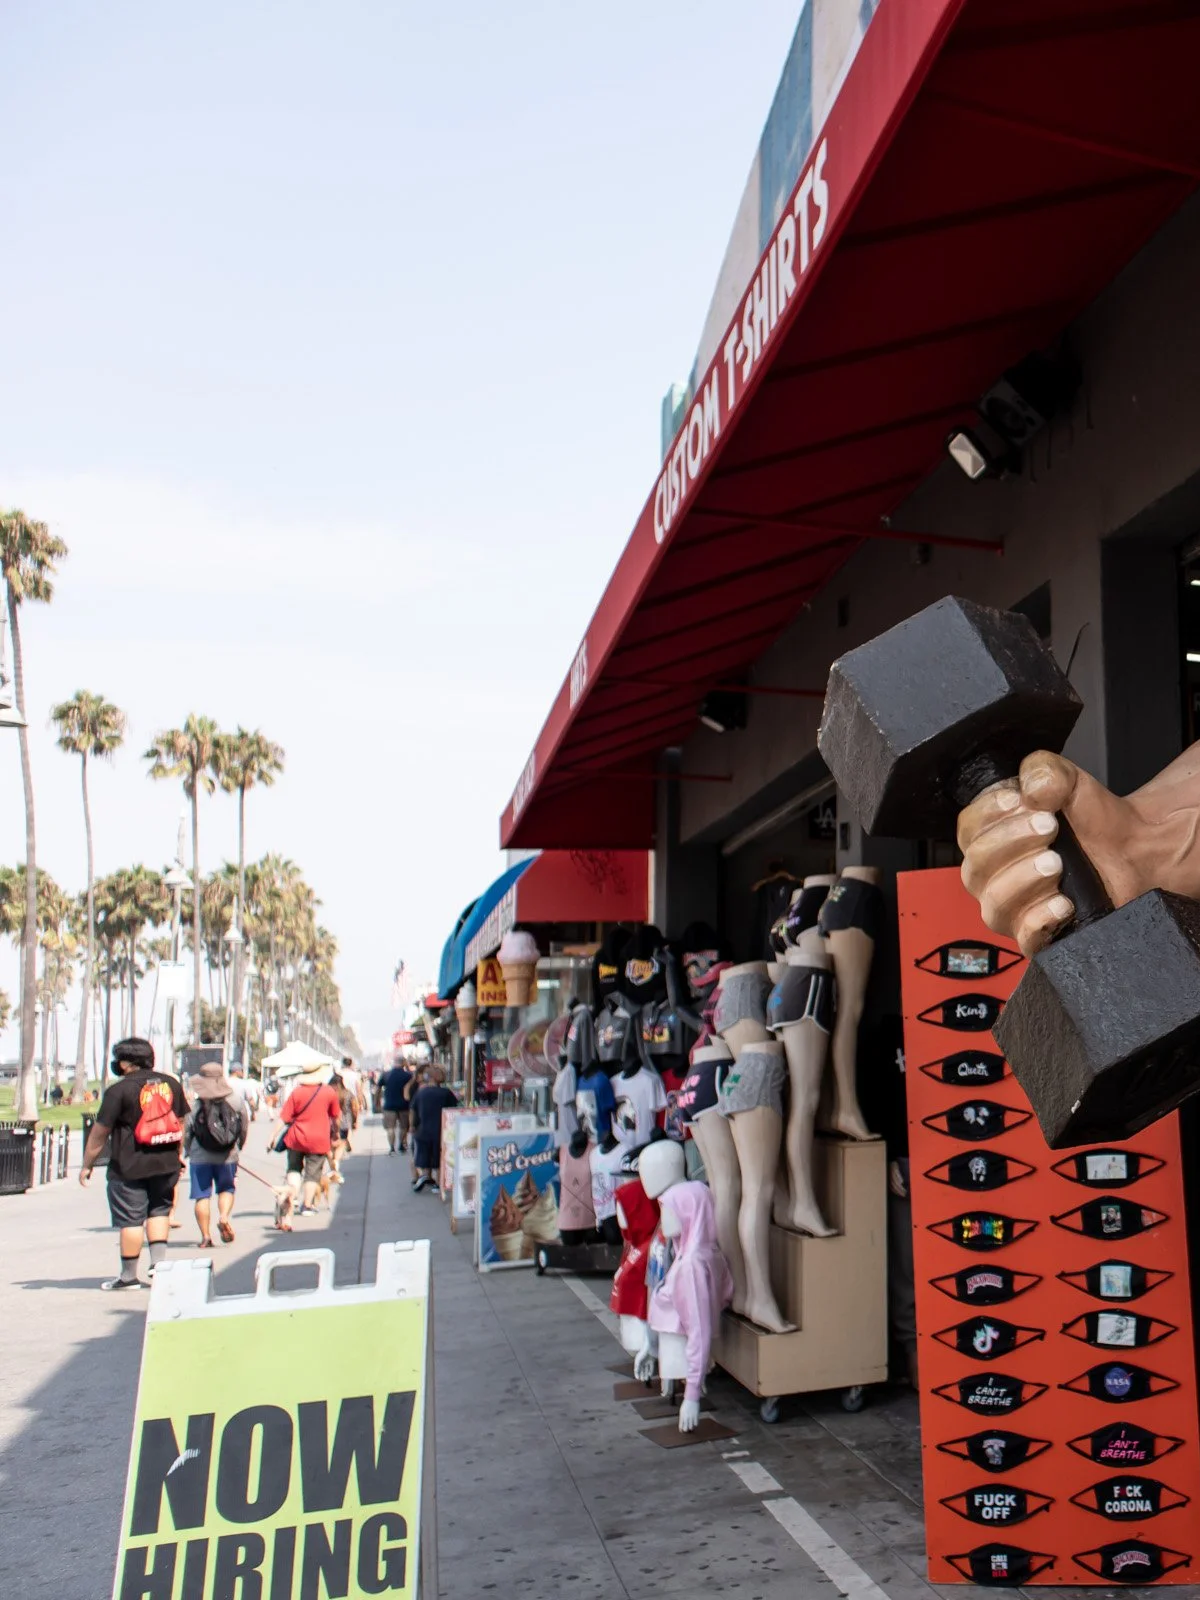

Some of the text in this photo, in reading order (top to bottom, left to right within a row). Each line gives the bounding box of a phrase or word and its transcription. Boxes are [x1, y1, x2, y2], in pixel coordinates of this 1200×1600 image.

[653, 136, 830, 546] CUSTOM T-SHIRTS
[955, 1002, 988, 1019] King
[487, 1141, 518, 1163] Soft
[488, 1161, 513, 1178] Ice
[1104, 1378, 1131, 1387] NASA
[975, 1386, 1008, 1397] CAN'T
[967, 1395, 1013, 1407] BREATHE
[1108, 1440, 1140, 1450] CAN'T
[1100, 1449, 1147, 1460] BREATHE
[130, 1390, 417, 1537] NOW
[973, 1493, 1017, 1507] FUCK
[1104, 1499, 1153, 1514] CORONA
[981, 1506, 1011, 1520] OFF
[119, 1512, 408, 1600] HIRING
